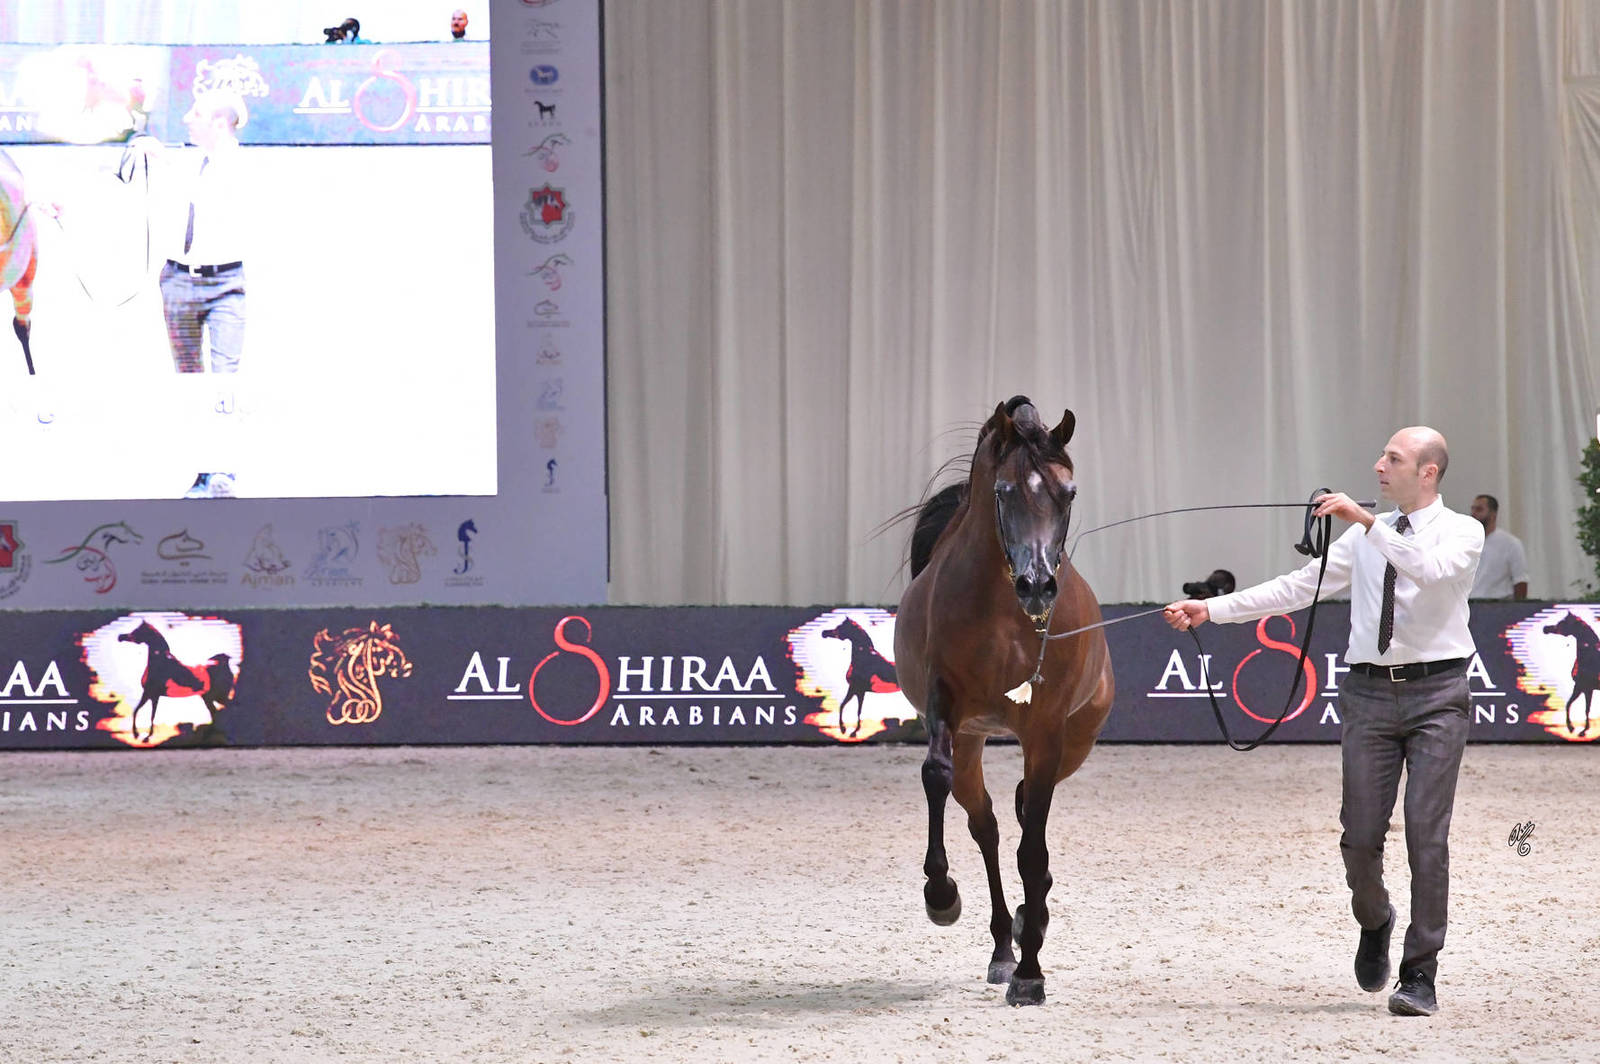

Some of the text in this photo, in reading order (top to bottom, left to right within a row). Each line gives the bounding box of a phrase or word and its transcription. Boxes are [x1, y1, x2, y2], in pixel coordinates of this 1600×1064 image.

[299, 76, 349, 108] AL
[414, 113, 487, 132] ARAB
[0, 660, 70, 697] AA
[454, 616, 777, 726] AL SHIRAA
[1154, 649, 1223, 690] AL
[610, 704, 796, 726] ARABIANS
